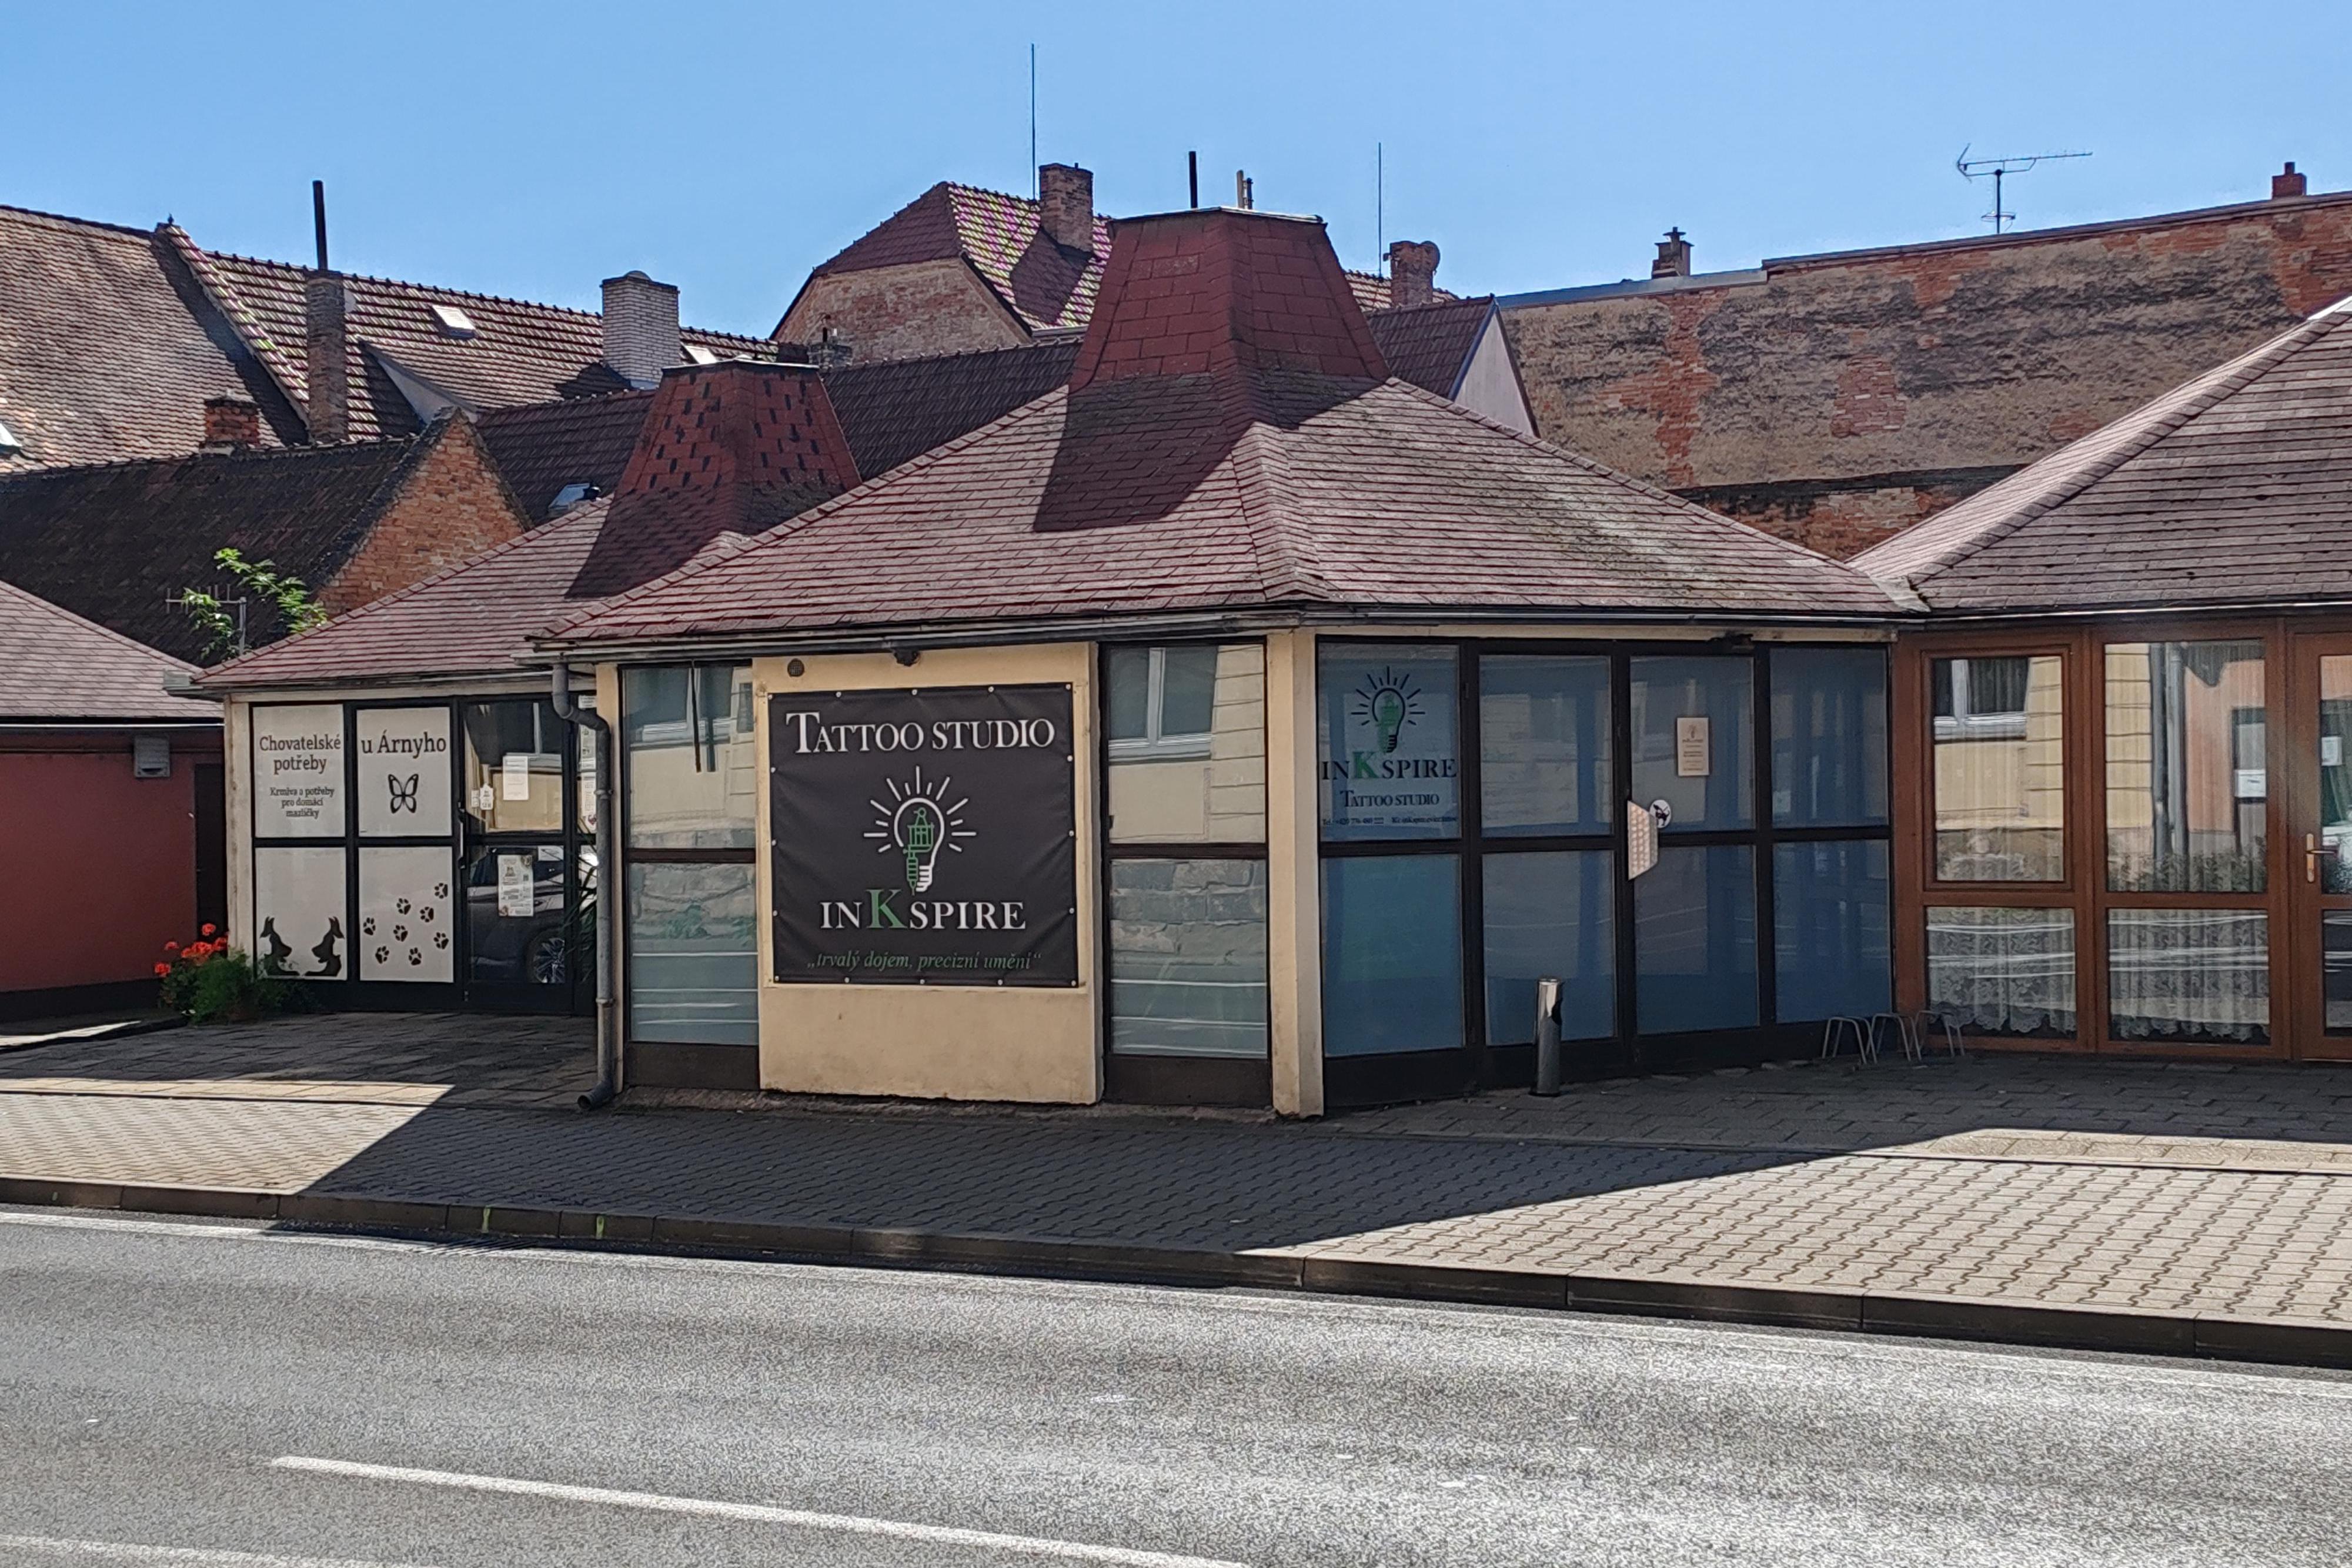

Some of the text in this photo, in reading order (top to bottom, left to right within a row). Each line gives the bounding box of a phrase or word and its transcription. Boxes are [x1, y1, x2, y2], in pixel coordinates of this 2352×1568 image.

[259, 734, 341, 751] Chovatelské
[361, 729, 447, 759] u Árnyho
[273, 754, 327, 775] potřeby
[305, 787, 335, 797] potřeby
[281, 800, 295, 809] pro
[917, 951, 980, 971] precizní
